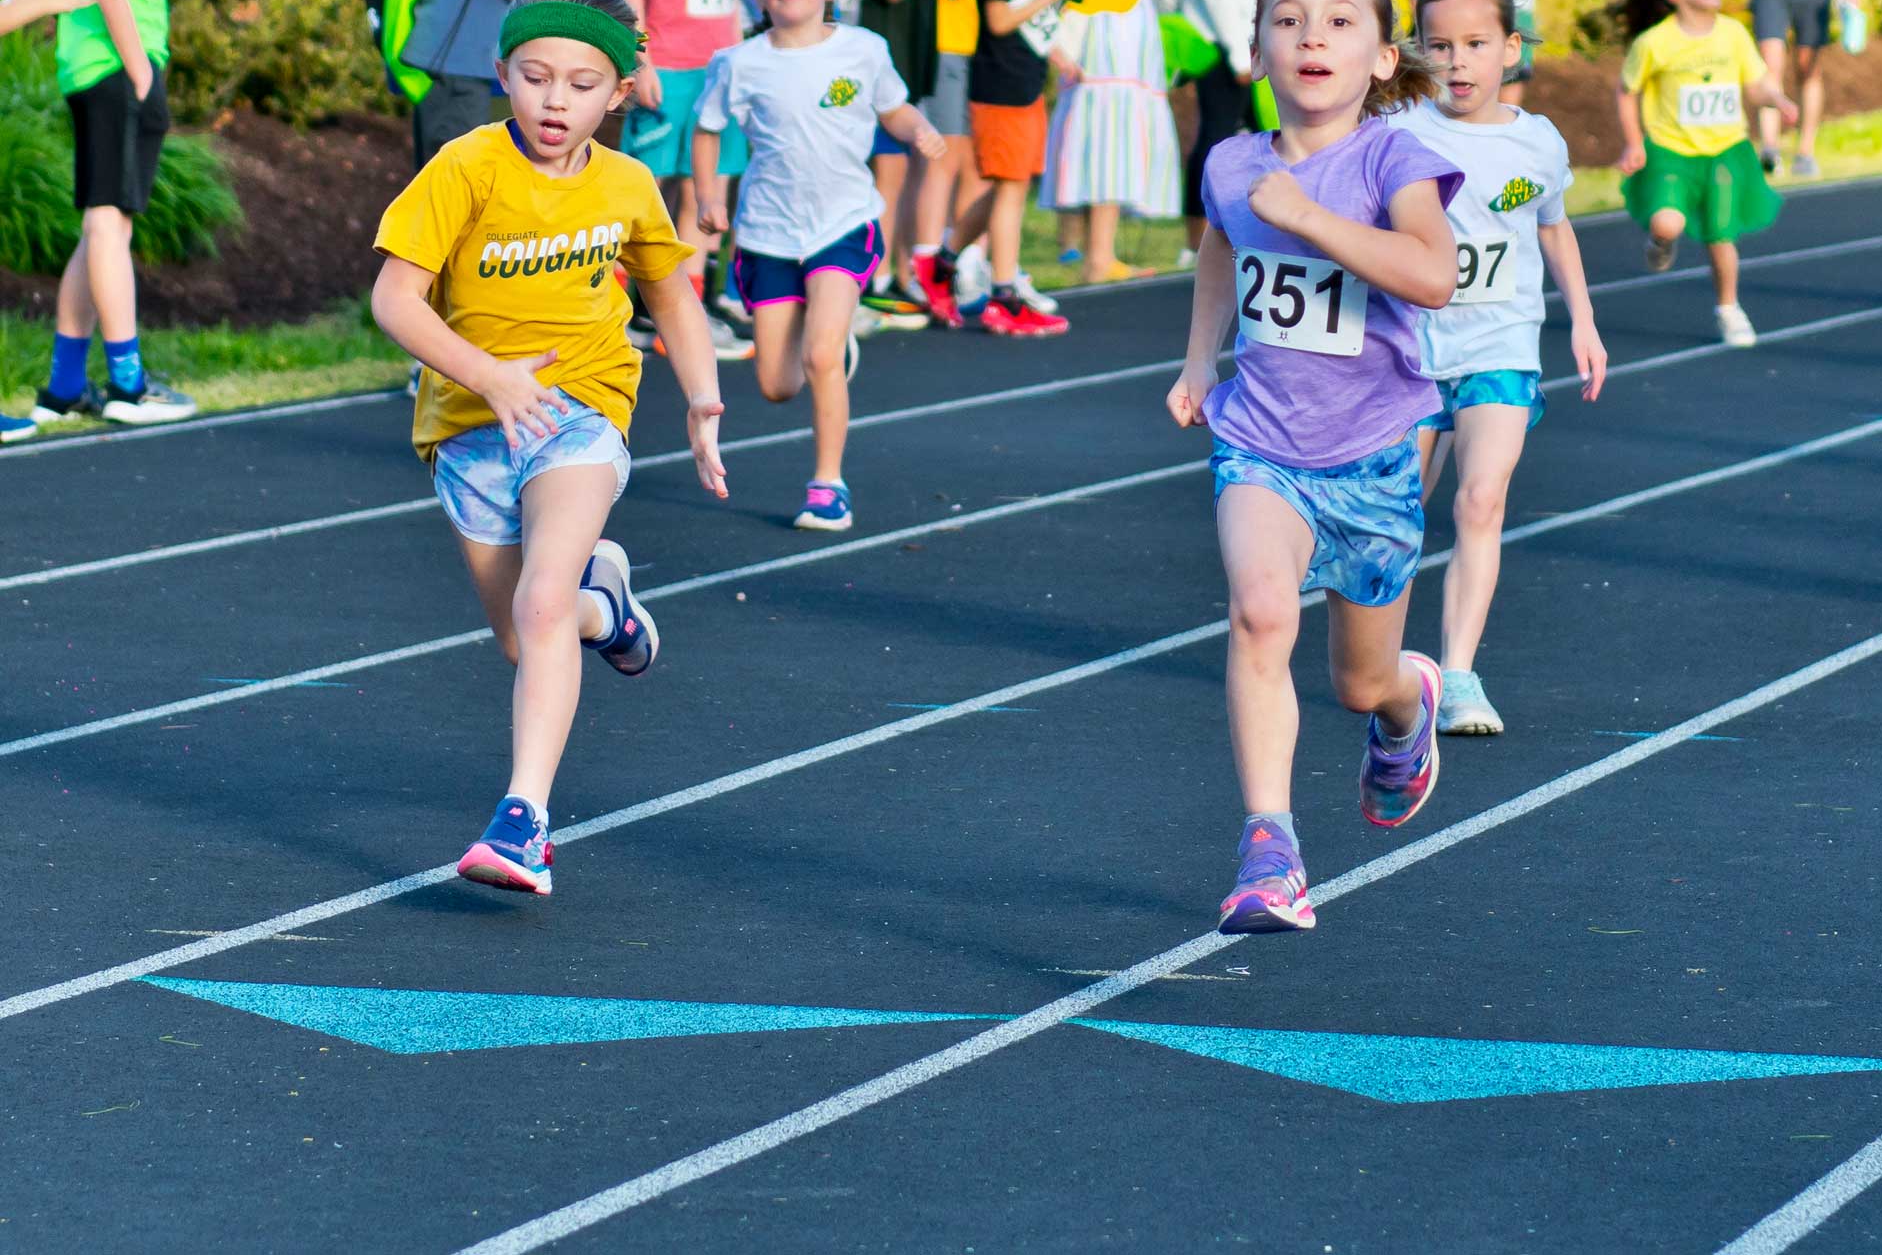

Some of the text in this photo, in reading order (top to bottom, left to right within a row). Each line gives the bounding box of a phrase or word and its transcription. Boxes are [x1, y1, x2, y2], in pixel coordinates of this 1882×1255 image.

[478, 221, 625, 279] COUGARS
[486, 230, 540, 241] COLLEGIATE
[1455, 240, 1509, 290] 97
[1240, 254, 1345, 334] 251
